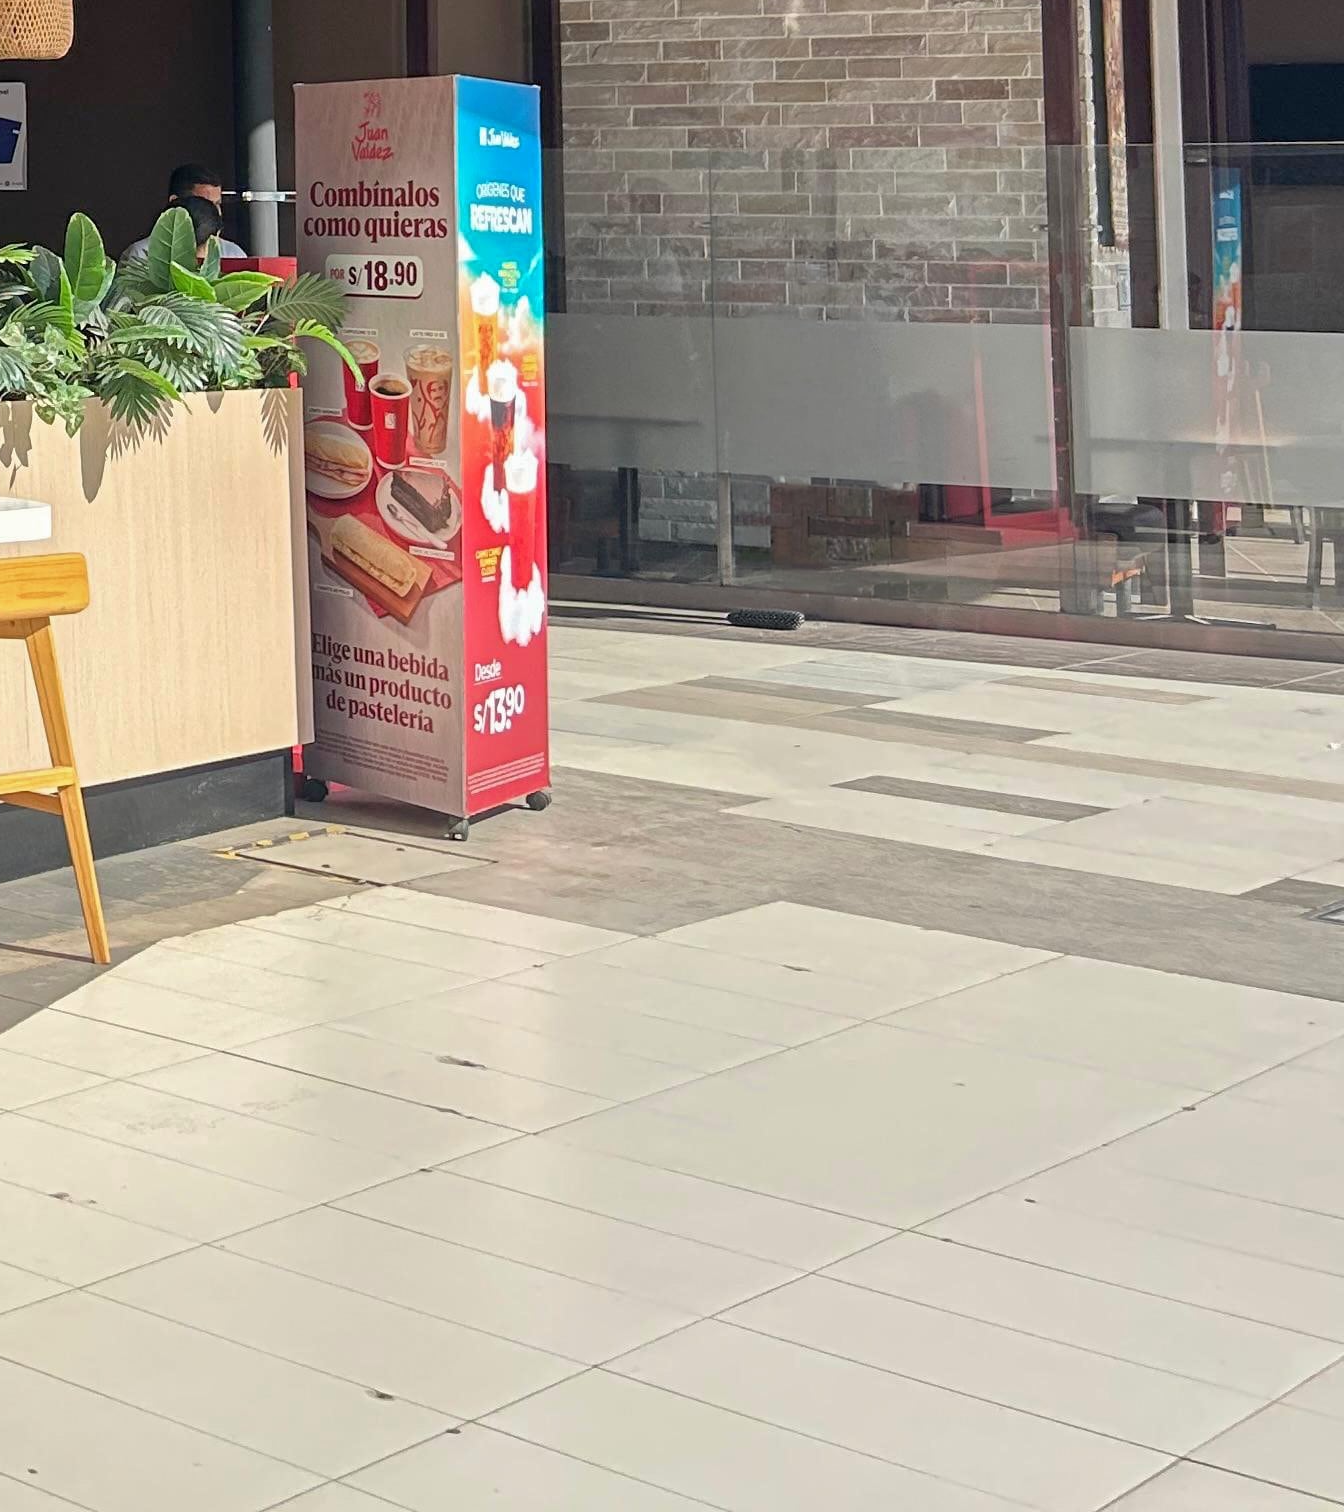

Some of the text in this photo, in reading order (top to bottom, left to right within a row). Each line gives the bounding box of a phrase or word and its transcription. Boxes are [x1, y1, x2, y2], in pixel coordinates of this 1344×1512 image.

[355, 121, 389, 143] Juan
[351, 141, 395, 161] Valdez
[310, 180, 440, 208] Combínalos
[511, 185, 525, 203] QUE
[304, 210, 448, 243] como quieras
[470, 203, 533, 235] REFRESCAN
[330, 268, 345, 280] POR
[312, 632, 449, 681] Elige una bebida
[474, 658, 502, 682] Desde
[312, 663, 452, 709] más un producto
[326, 690, 434, 734] de pastelería
